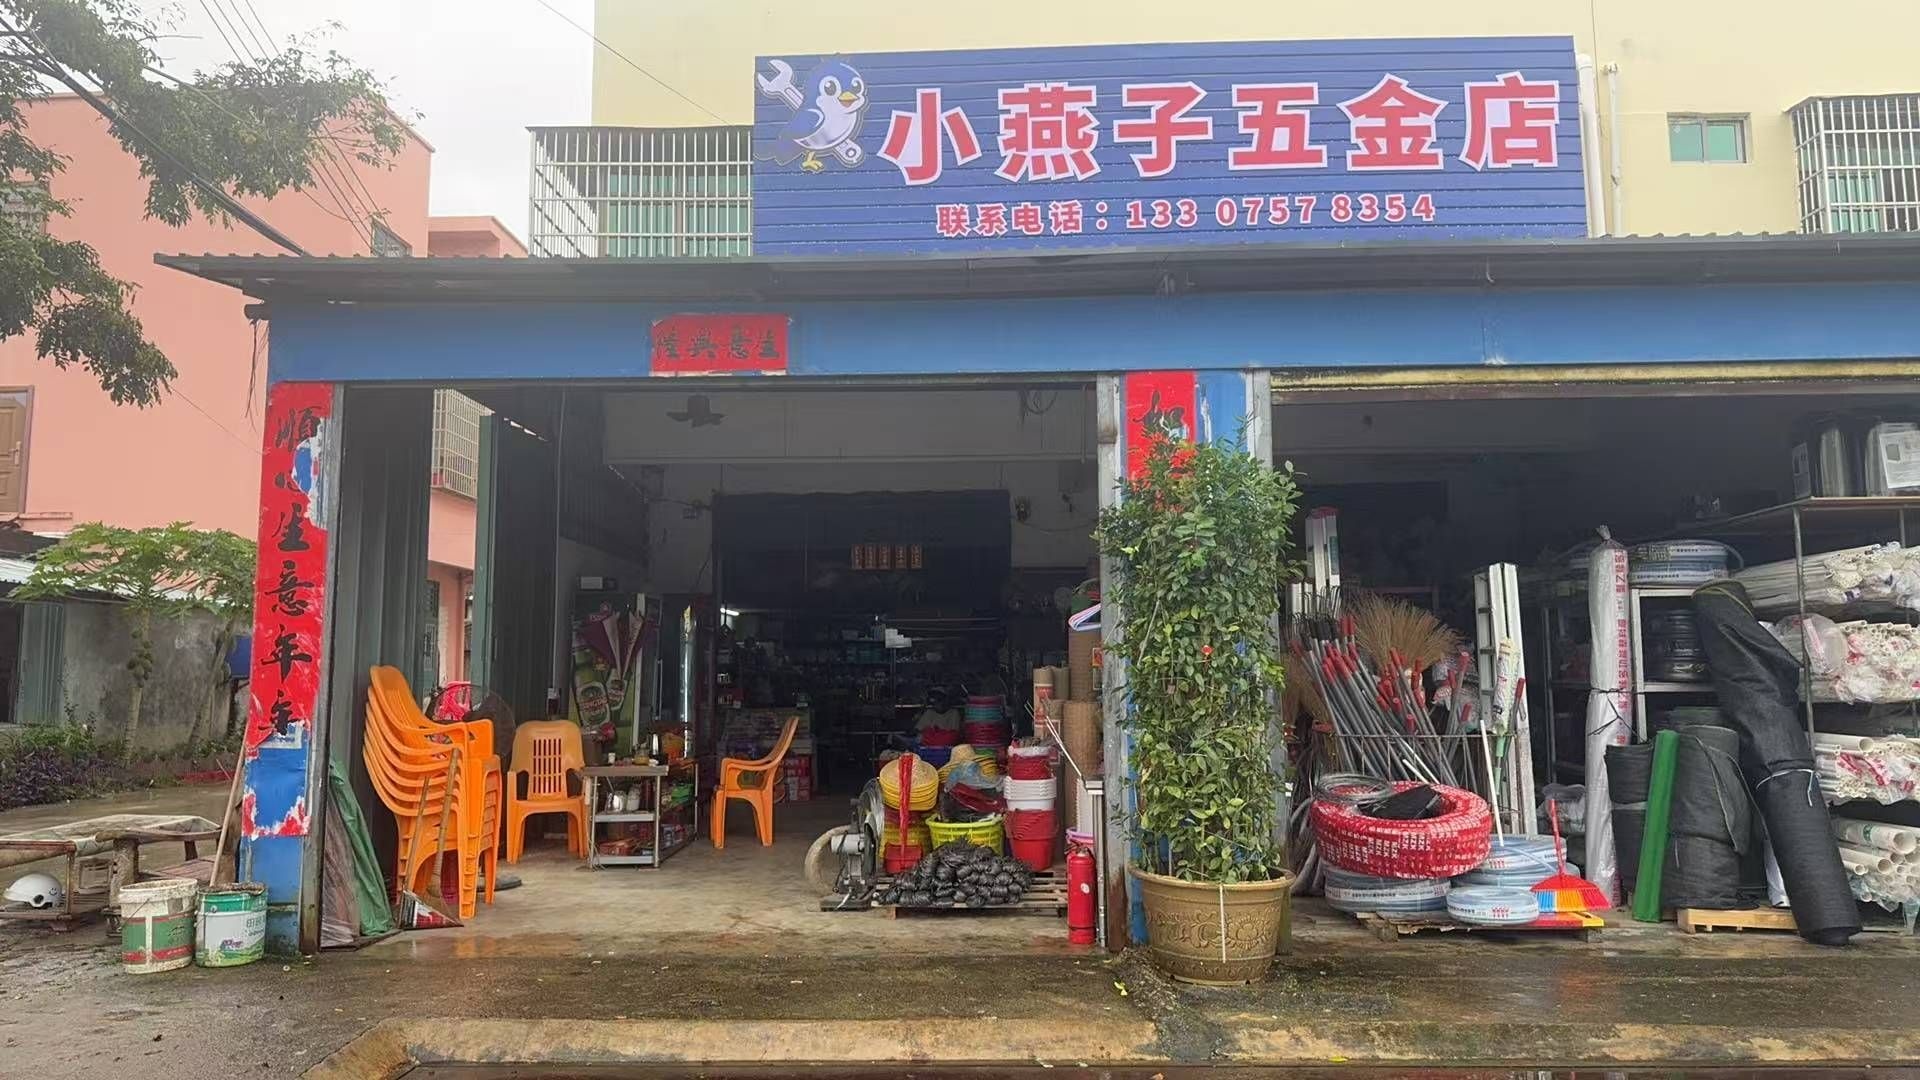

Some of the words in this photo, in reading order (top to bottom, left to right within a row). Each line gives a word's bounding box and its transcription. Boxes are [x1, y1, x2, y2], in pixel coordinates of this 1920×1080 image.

[879, 71, 1560, 186] 小燕子五金店
[1215, 196, 1317, 226] 0757
[1331, 193, 1436, 222] 8354
